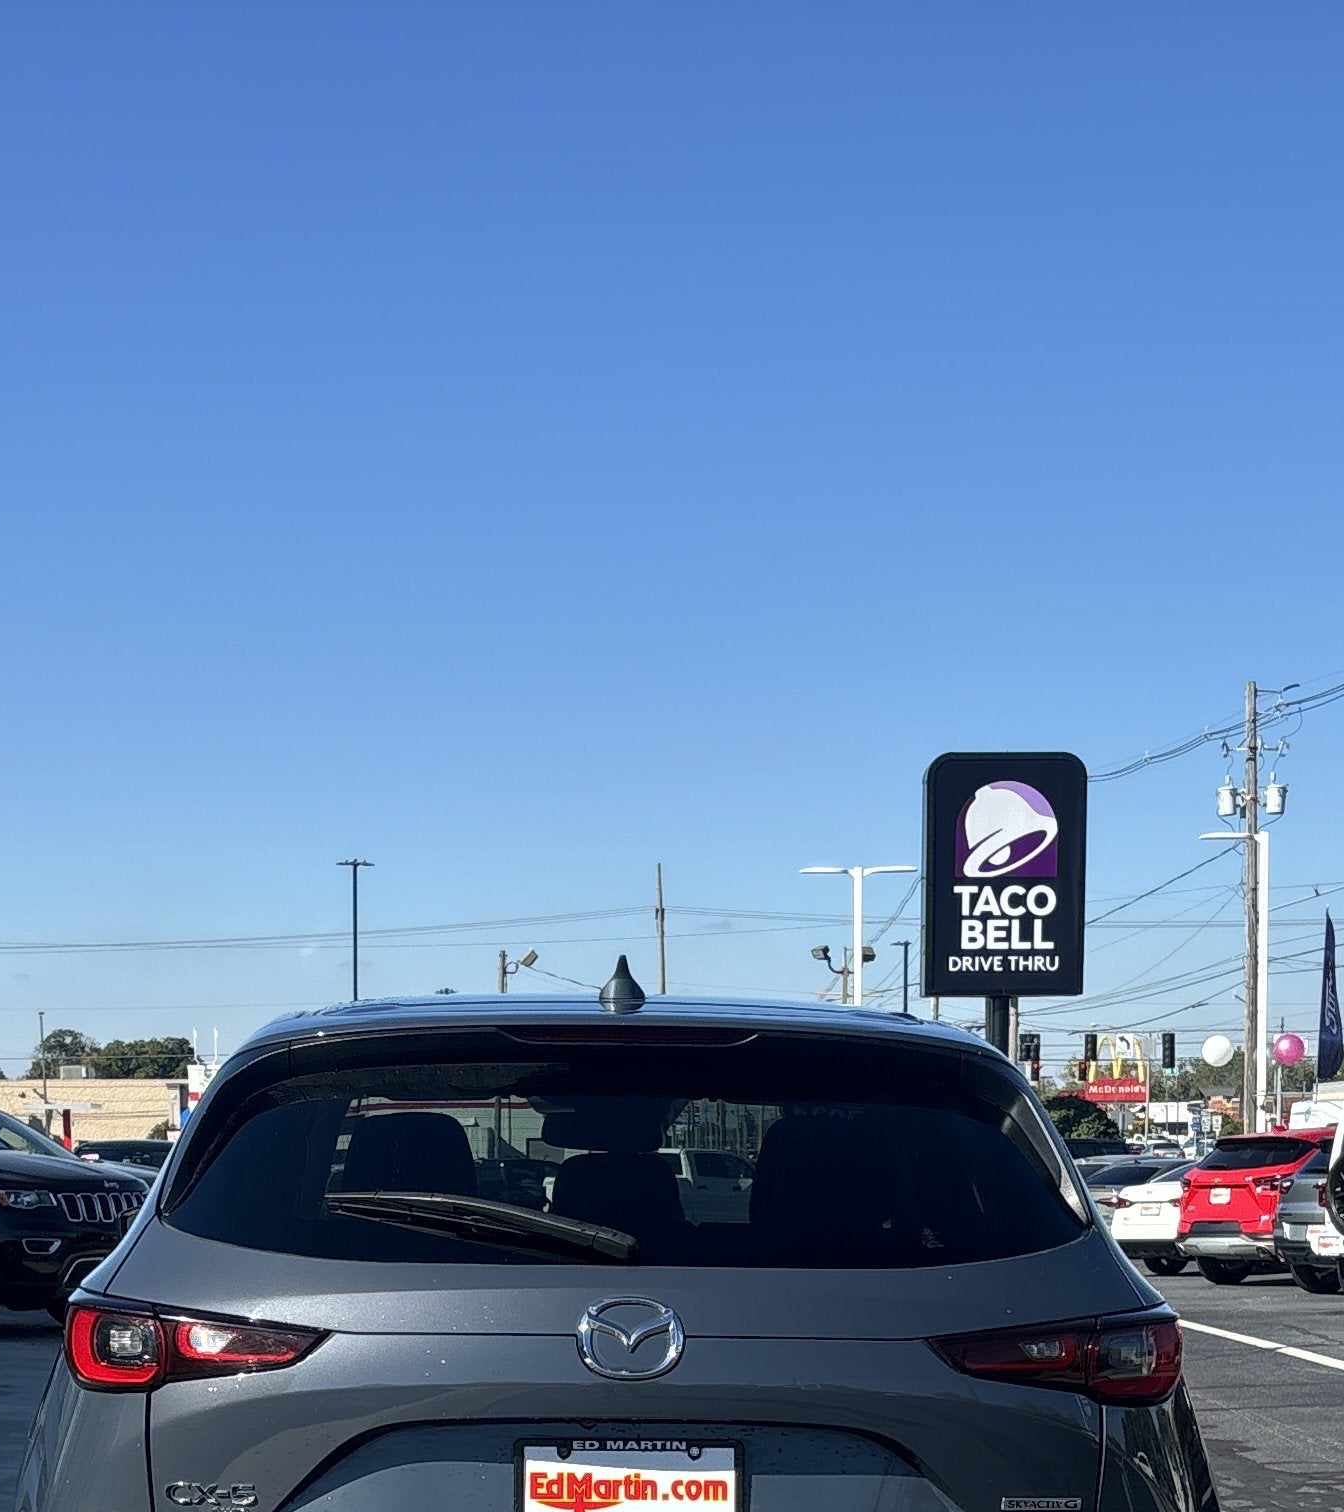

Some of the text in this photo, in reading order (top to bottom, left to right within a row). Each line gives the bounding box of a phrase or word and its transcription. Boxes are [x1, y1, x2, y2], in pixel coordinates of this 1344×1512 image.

[953, 885, 1057, 916] TACO
[961, 919, 1055, 949] BELL
[948, 956, 1059, 971] DRIVE THRU
[572, 1440, 687, 1451] ED MARTIN
[165, 1481, 258, 1507] CX-5
